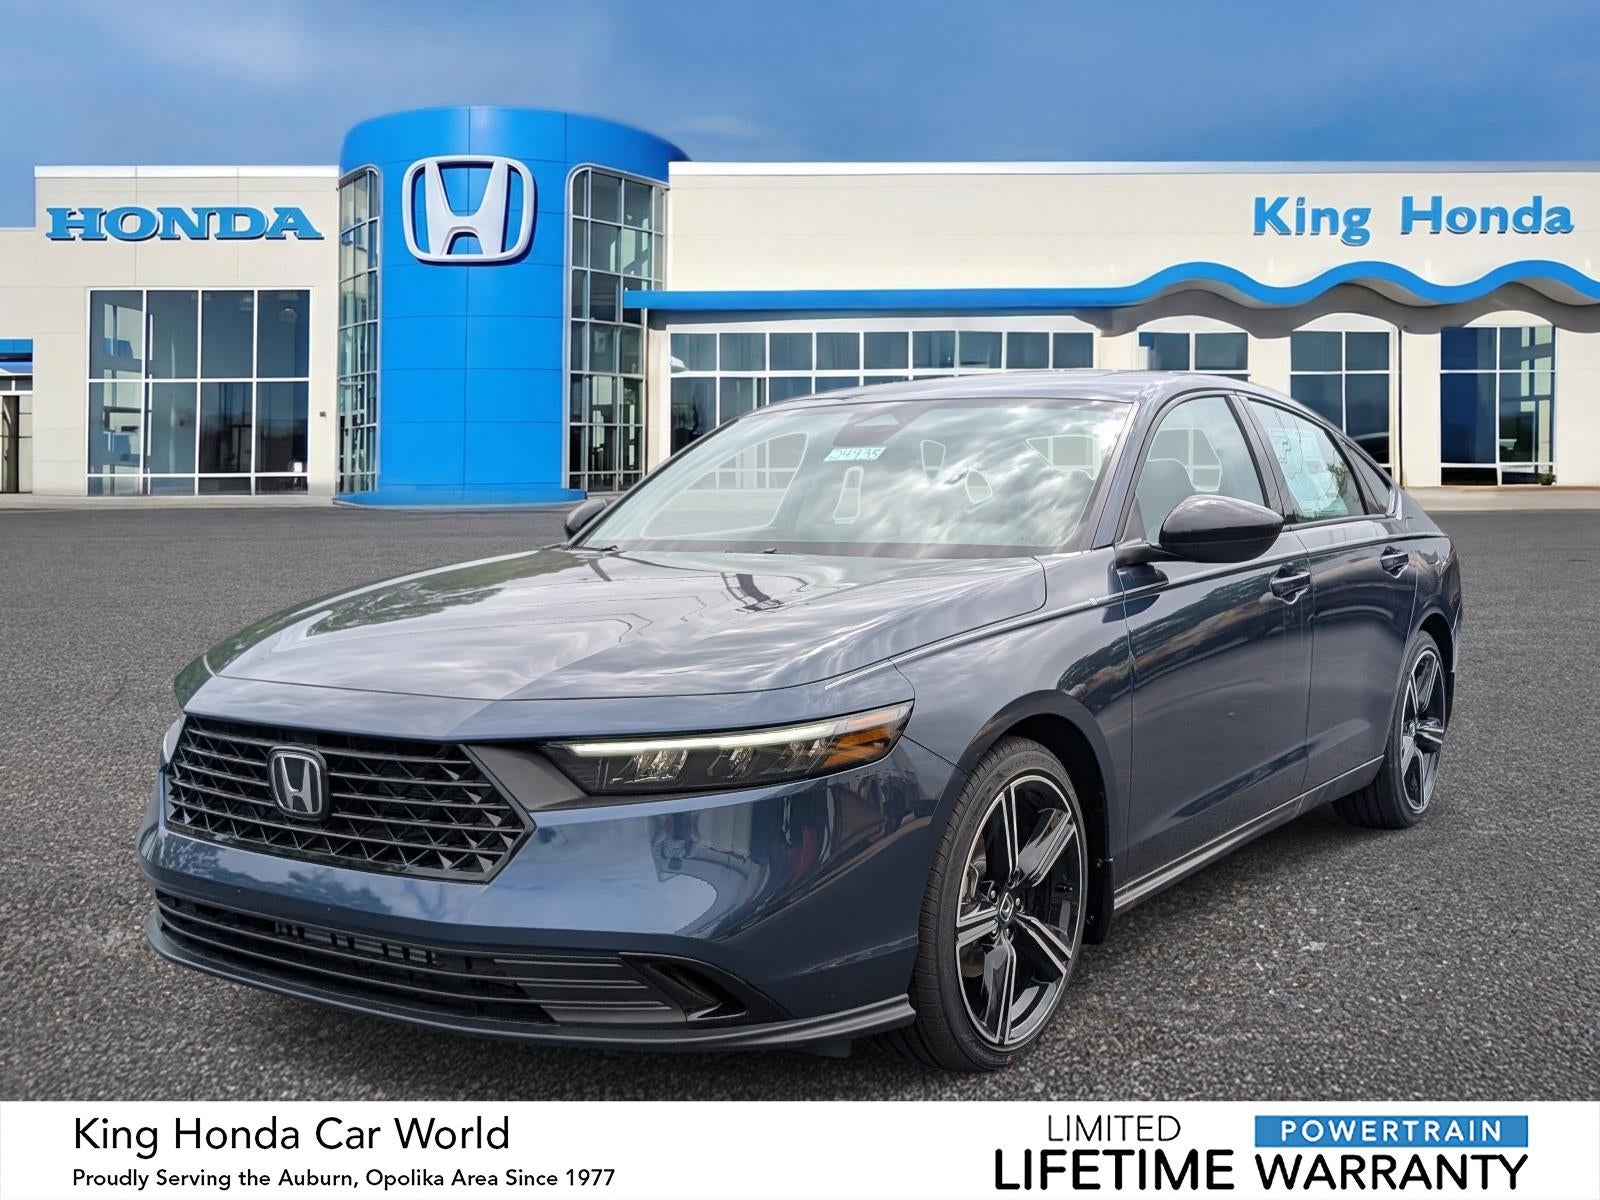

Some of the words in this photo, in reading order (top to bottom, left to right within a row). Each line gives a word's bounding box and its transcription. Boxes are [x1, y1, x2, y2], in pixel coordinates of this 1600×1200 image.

[46, 206, 323, 241] HONDA
[1253, 196, 1371, 245] King
[1401, 195, 1574, 234] Honda
